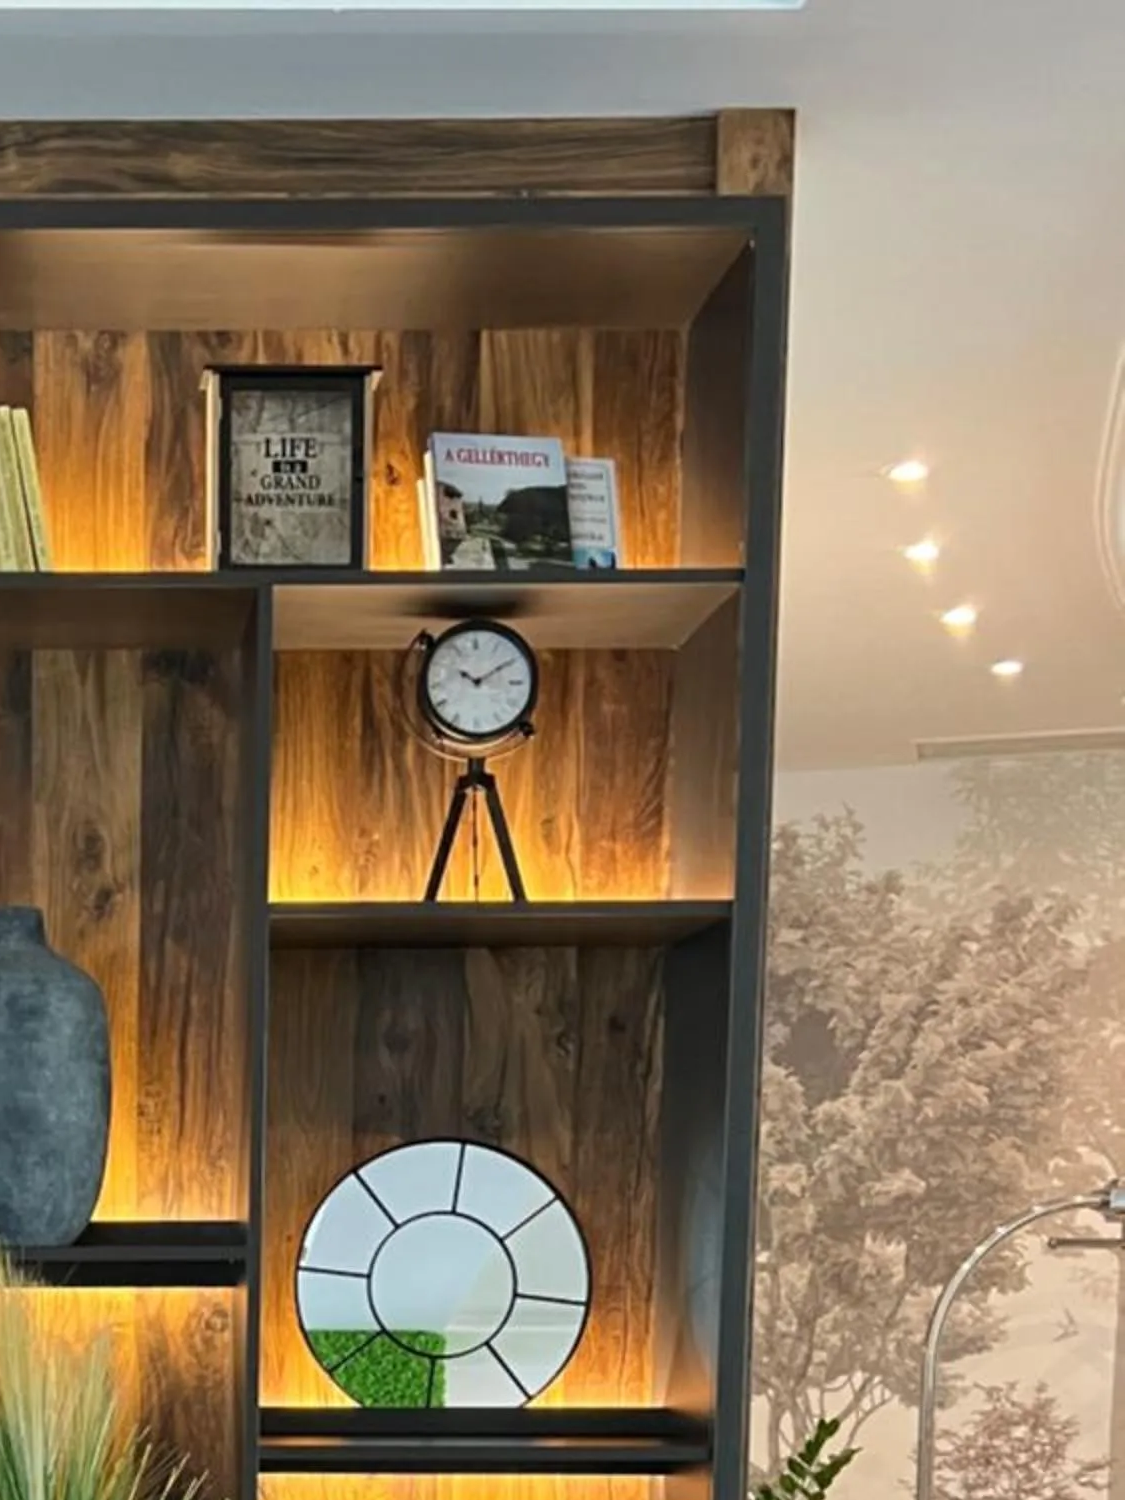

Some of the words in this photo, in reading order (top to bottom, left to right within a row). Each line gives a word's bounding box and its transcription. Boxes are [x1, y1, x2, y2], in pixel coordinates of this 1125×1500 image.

[264, 437, 317, 458] LIFE
[444, 447, 455, 462] A
[260, 475, 321, 490] GRAND
[246, 493, 335, 506] ADVENTURE
